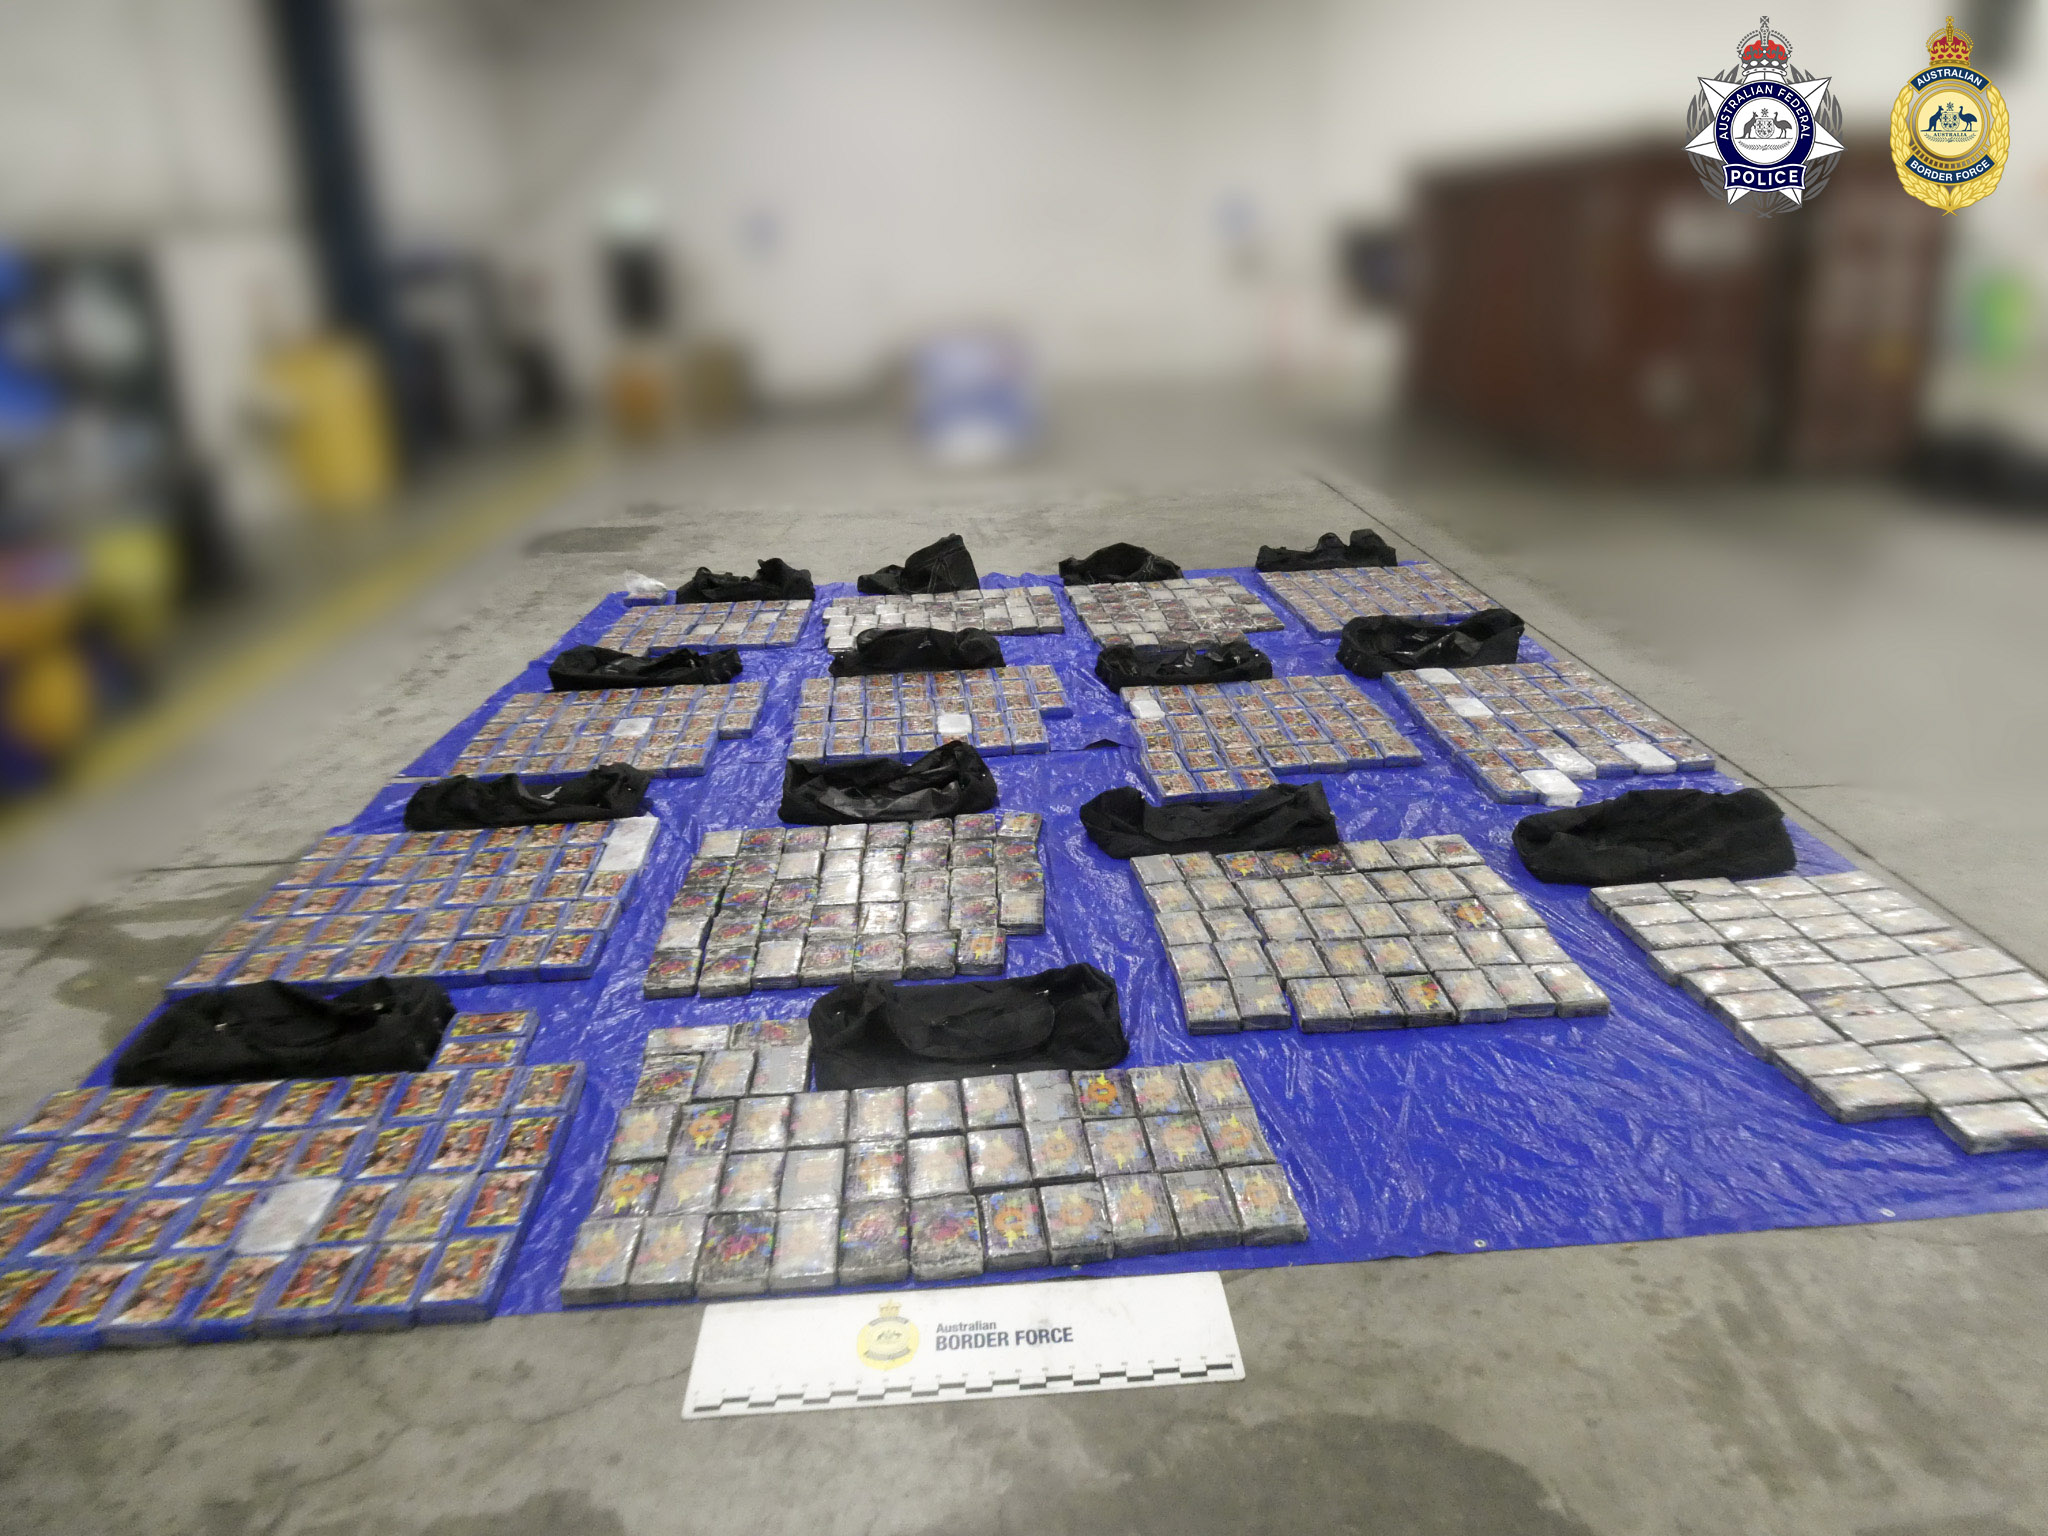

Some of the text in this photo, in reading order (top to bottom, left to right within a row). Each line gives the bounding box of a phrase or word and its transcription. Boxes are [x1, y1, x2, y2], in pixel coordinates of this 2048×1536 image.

[936, 1320, 997, 1334] Australian
[936, 1327, 1073, 1351] BORDER FORCE
